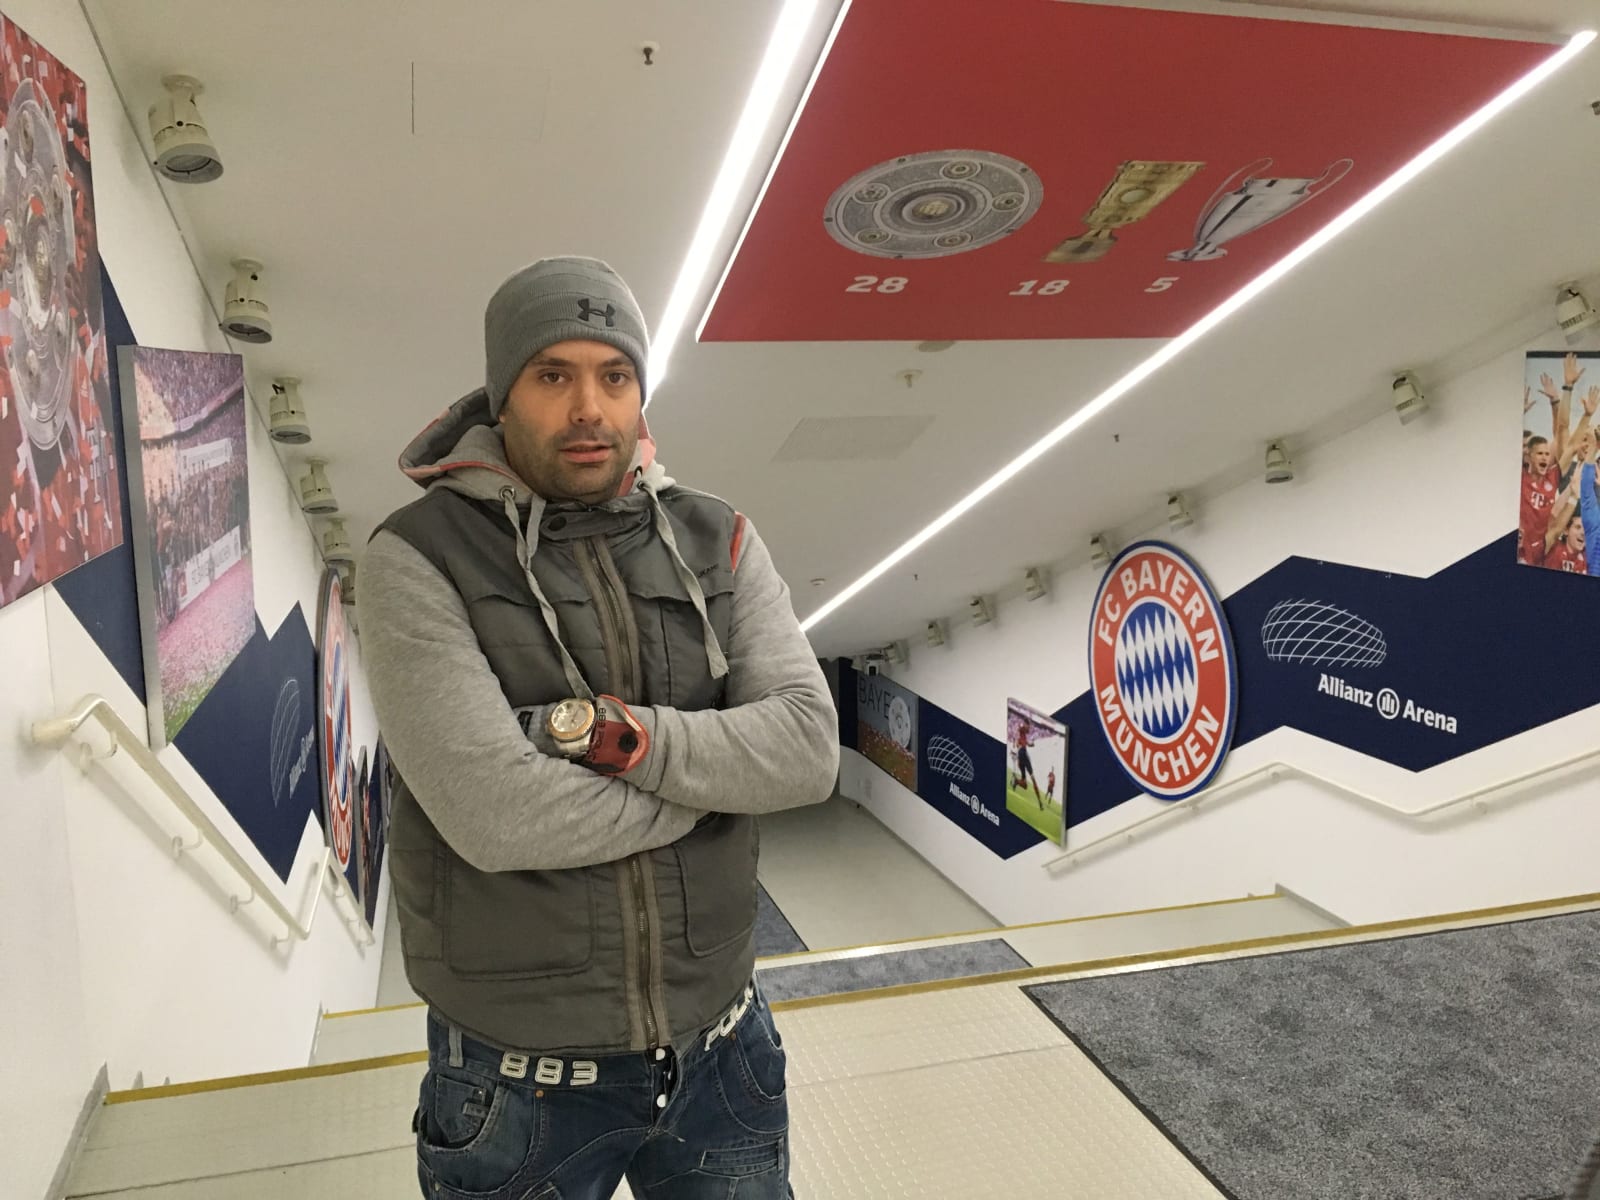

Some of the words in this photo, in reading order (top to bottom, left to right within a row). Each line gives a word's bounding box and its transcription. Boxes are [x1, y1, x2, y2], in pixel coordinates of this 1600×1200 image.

[845, 275, 909, 294] 28
[1009, 279, 1071, 297] 18
[1144, 277, 1179, 294] 5
[1099, 600, 1121, 647] FC
[1119, 558, 1220, 664] BAYERN
[1317, 673, 1374, 709] Allianz
[1402, 700, 1458, 735] Arena
[1100, 684, 1219, 783] MÜNCHEN
[499, 1051, 598, 1086] 883
